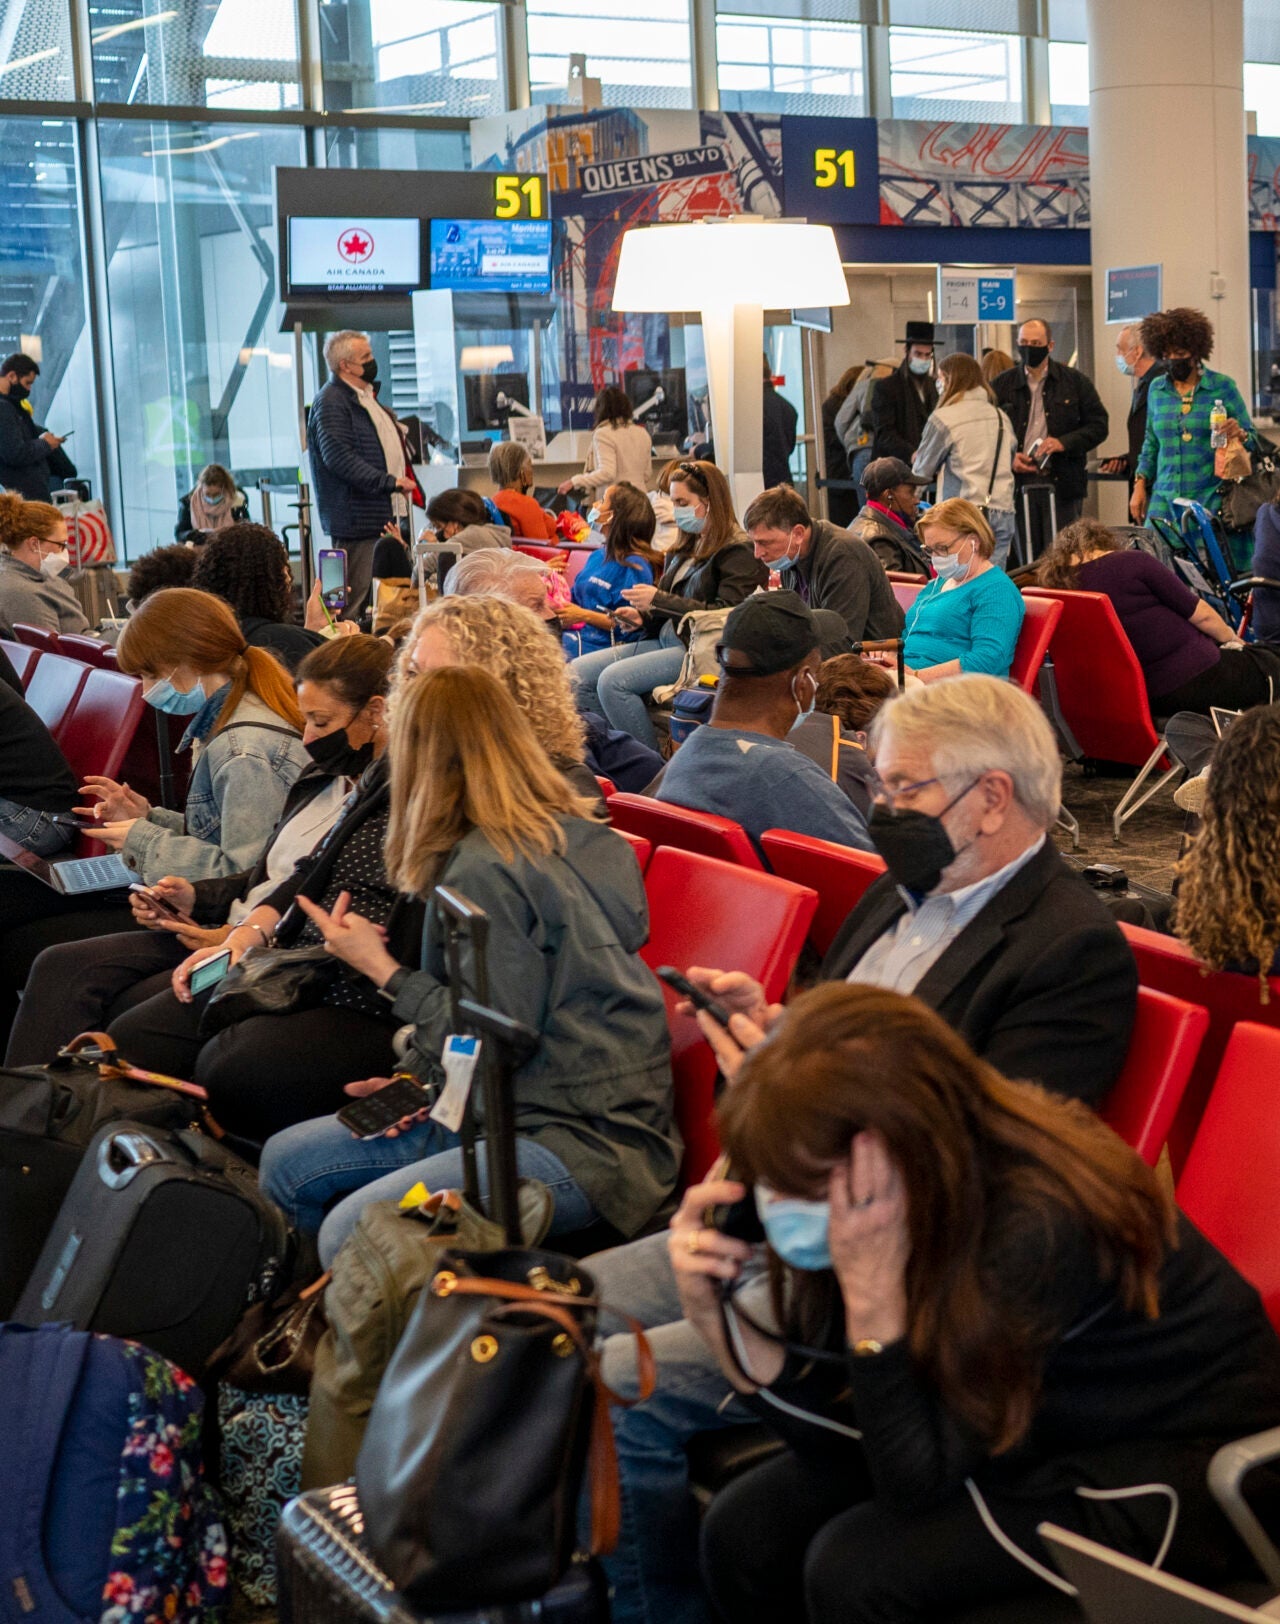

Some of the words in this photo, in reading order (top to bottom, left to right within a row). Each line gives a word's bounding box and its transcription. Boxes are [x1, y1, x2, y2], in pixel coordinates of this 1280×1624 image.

[583, 156, 674, 193] QUEENS
[673, 147, 721, 167] BLVD
[815, 148, 856, 188] 51
[495, 176, 542, 218] 51
[326, 268, 346, 276] AIR
[348, 268, 386, 276] CANADA
